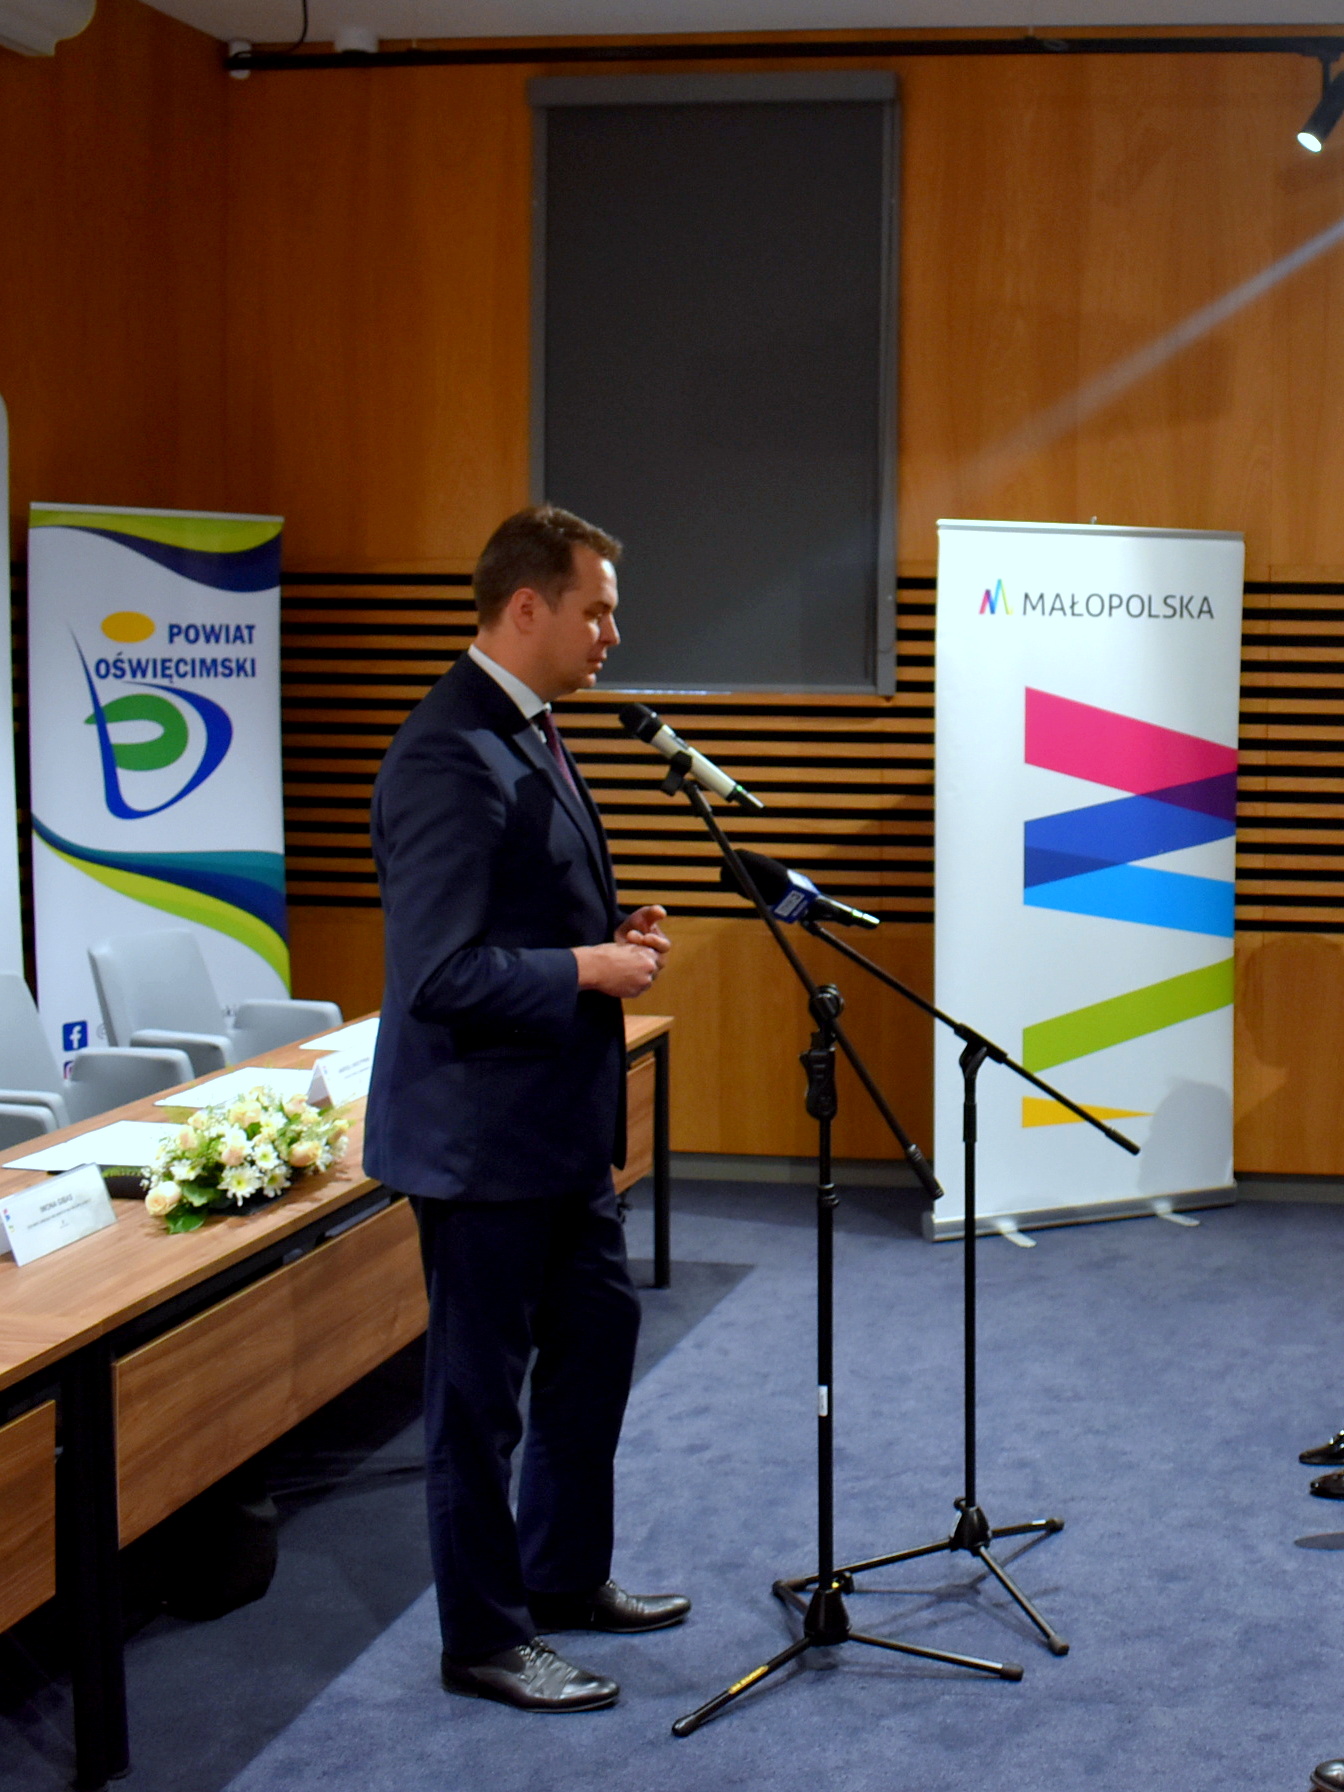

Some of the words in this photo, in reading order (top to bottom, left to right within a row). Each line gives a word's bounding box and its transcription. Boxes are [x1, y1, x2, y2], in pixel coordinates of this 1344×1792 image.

[1022, 591, 1215, 620] MAŁOPOLSKA
[168, 624, 256, 645] POWIAT
[95, 651, 257, 683] OŚWIĘCIMSKI
